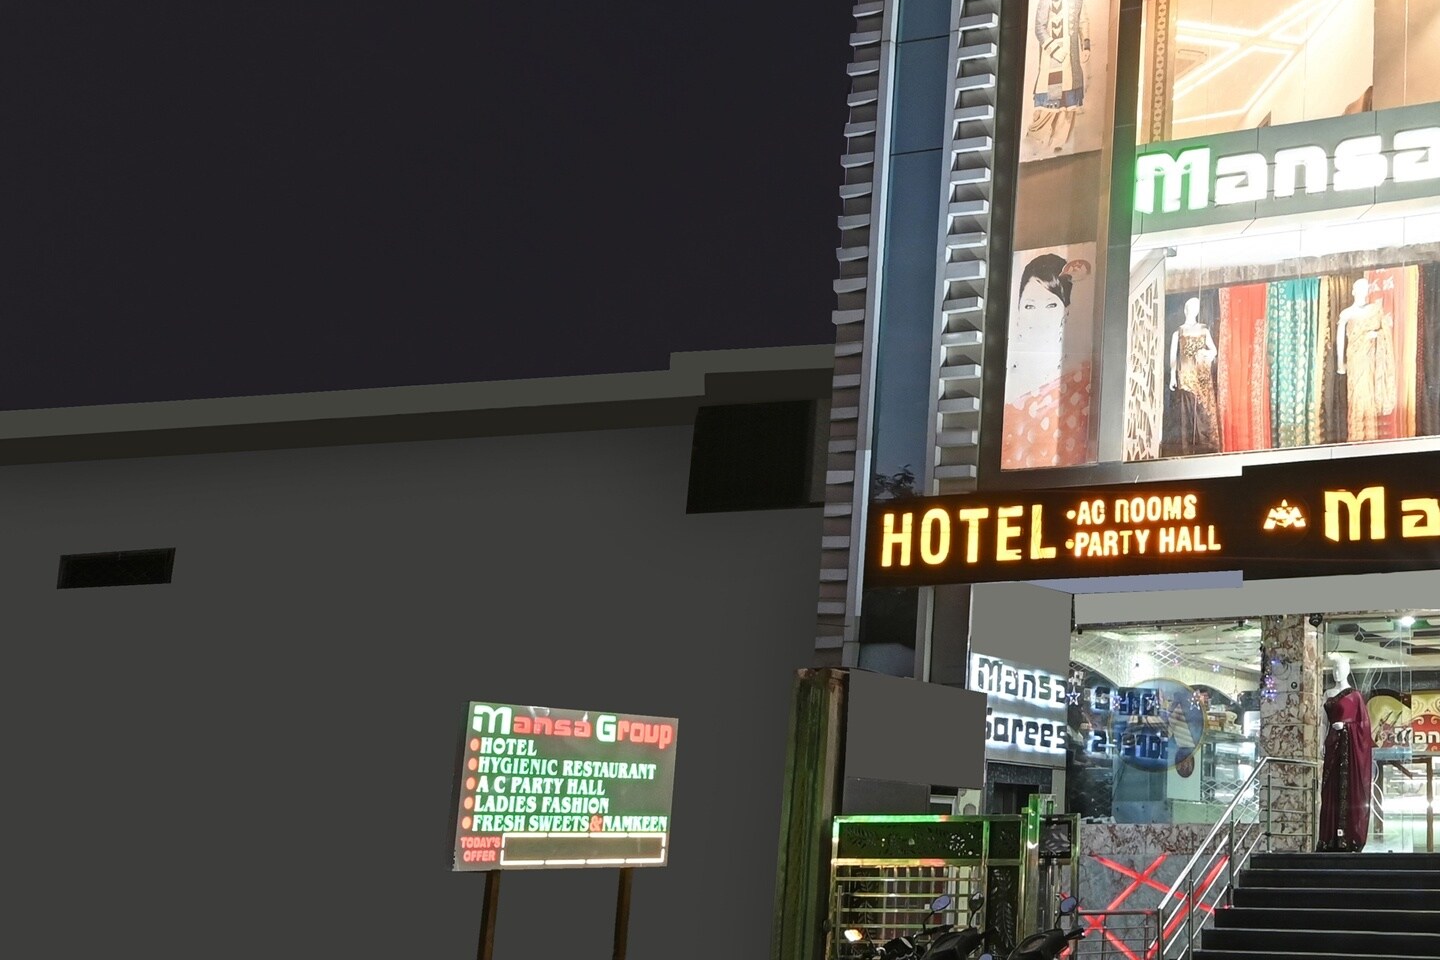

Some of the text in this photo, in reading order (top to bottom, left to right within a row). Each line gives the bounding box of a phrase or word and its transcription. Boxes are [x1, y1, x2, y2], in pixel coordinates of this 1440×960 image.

[881, 504, 1057, 567] HOTEL
[1074, 525, 1222, 557] PARTY HALL
[472, 705, 673, 749] Mansa Group
[480, 737, 537, 756] HOTEL
[477, 757, 656, 780] HYGIENIC RESTAURANT
[510, 777, 564, 794] PARTY
[567, 779, 605, 795] HALL
[474, 795, 609, 814] LADIES FASHION
[471, 815, 526, 832] FRESH
[460, 837, 500, 849] TODAY'S
[463, 850, 495, 862] OFFER
